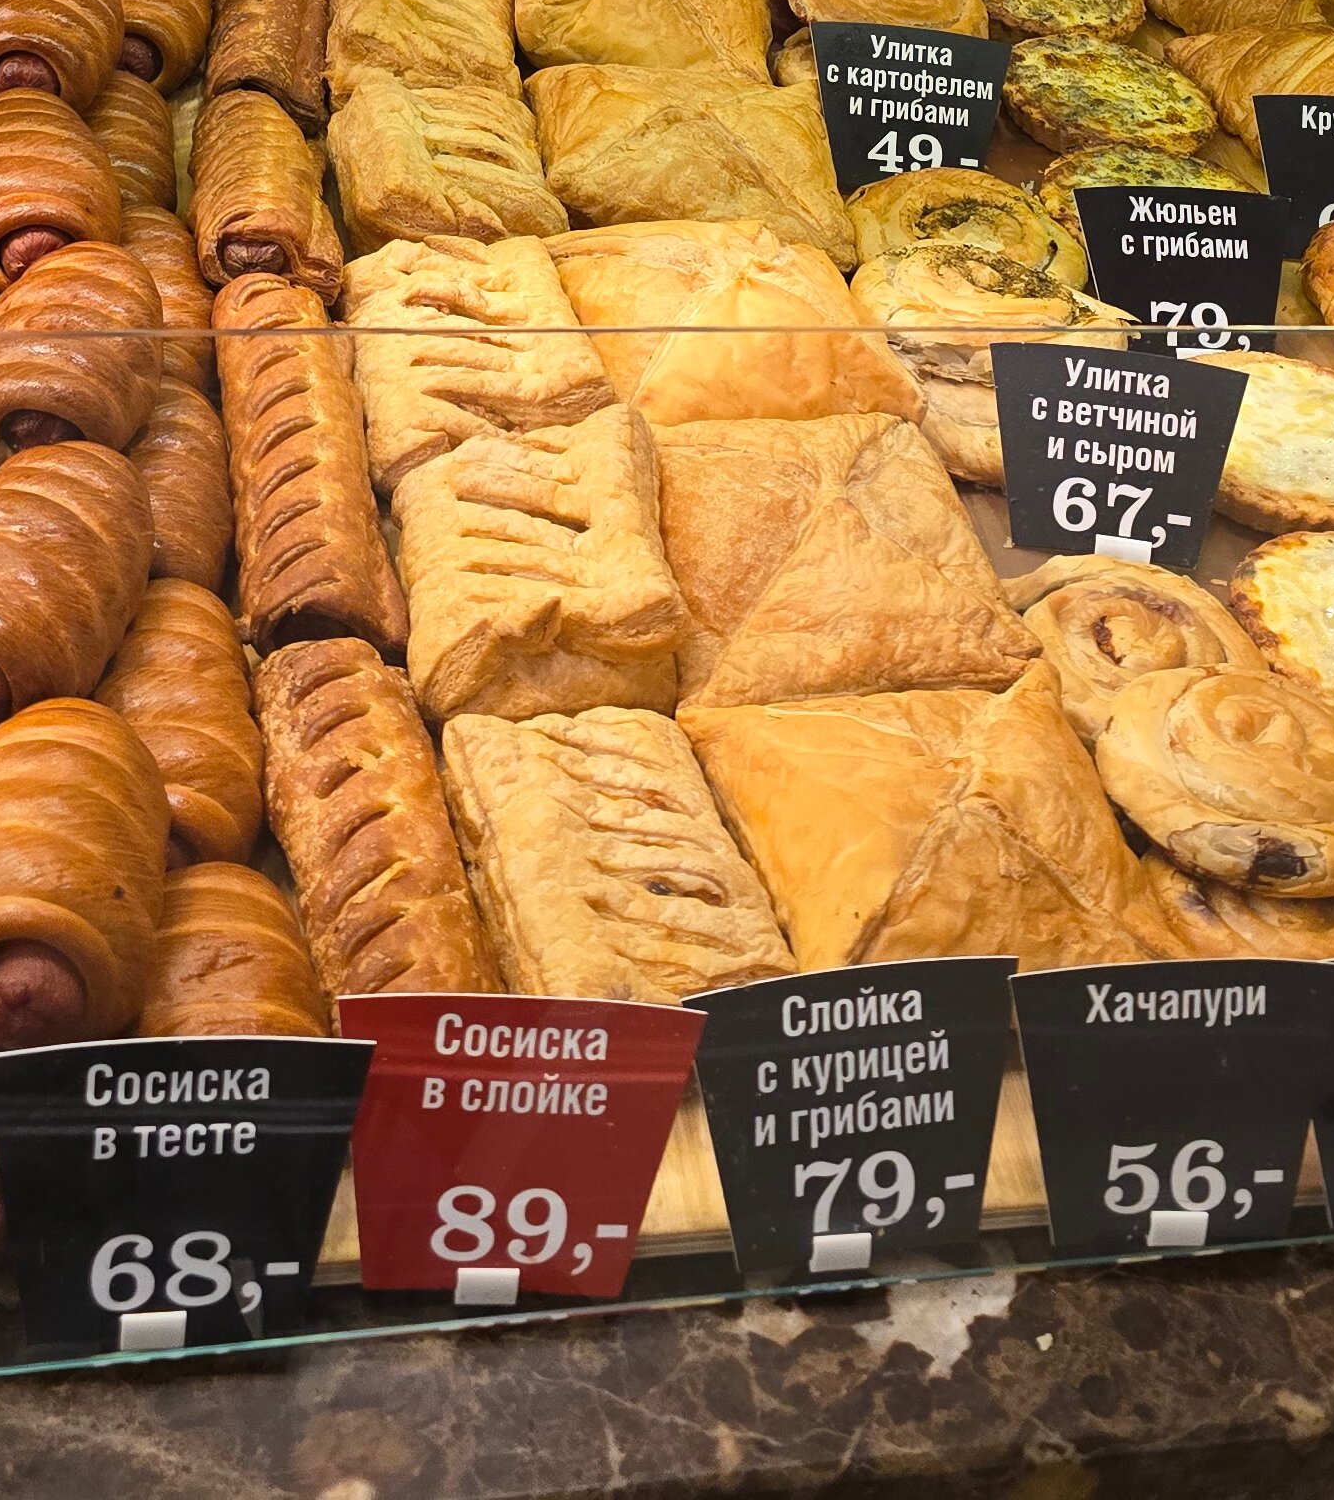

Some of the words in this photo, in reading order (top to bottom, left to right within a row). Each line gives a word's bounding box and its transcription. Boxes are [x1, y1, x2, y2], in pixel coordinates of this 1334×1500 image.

[870, 35, 952, 66] Улитка
[827, 64, 839, 83] с
[847, 66, 993, 100] картофелем
[849, 96, 862, 115] и
[870, 98, 969, 127] грибами
[867, 130, 979, 173] 49-
[1128, 196, 1237, 226] Жюльен
[1121, 235, 1135, 255] с
[1143, 232, 1249, 261] грибами
[1065, 357, 1170, 399] Улитка
[1032, 397, 1047, 420] с
[1057, 400, 1197, 439] ветчиной
[1047, 436, 1065, 460] и
[1074, 439, 1175, 474] сыром
[1052, 477, 1191, 548] 67,-
[782, 986, 923, 1037] Слойка
[1085, 984, 1266, 1028] Хачапури
[434, 1012, 608, 1061] Сосиска
[757, 1061, 777, 1093] с
[791, 1029, 950, 1095] курицей
[85, 1063, 271, 1107] Сосиска
[422, 1077, 446, 1109] в
[461, 1073, 607, 1116] слойке
[93, 1127, 116, 1160] в
[133, 1120, 257, 1158] тесте
[754, 1114, 776, 1147] и
[790, 1090, 955, 1149] грибами
[794, 1150, 975, 1233] 79,-
[1104, 1139, 1284, 1220] 56,-
[430, 1185, 628, 1276] 89,-
[90, 1230, 300, 1314] 68,-
